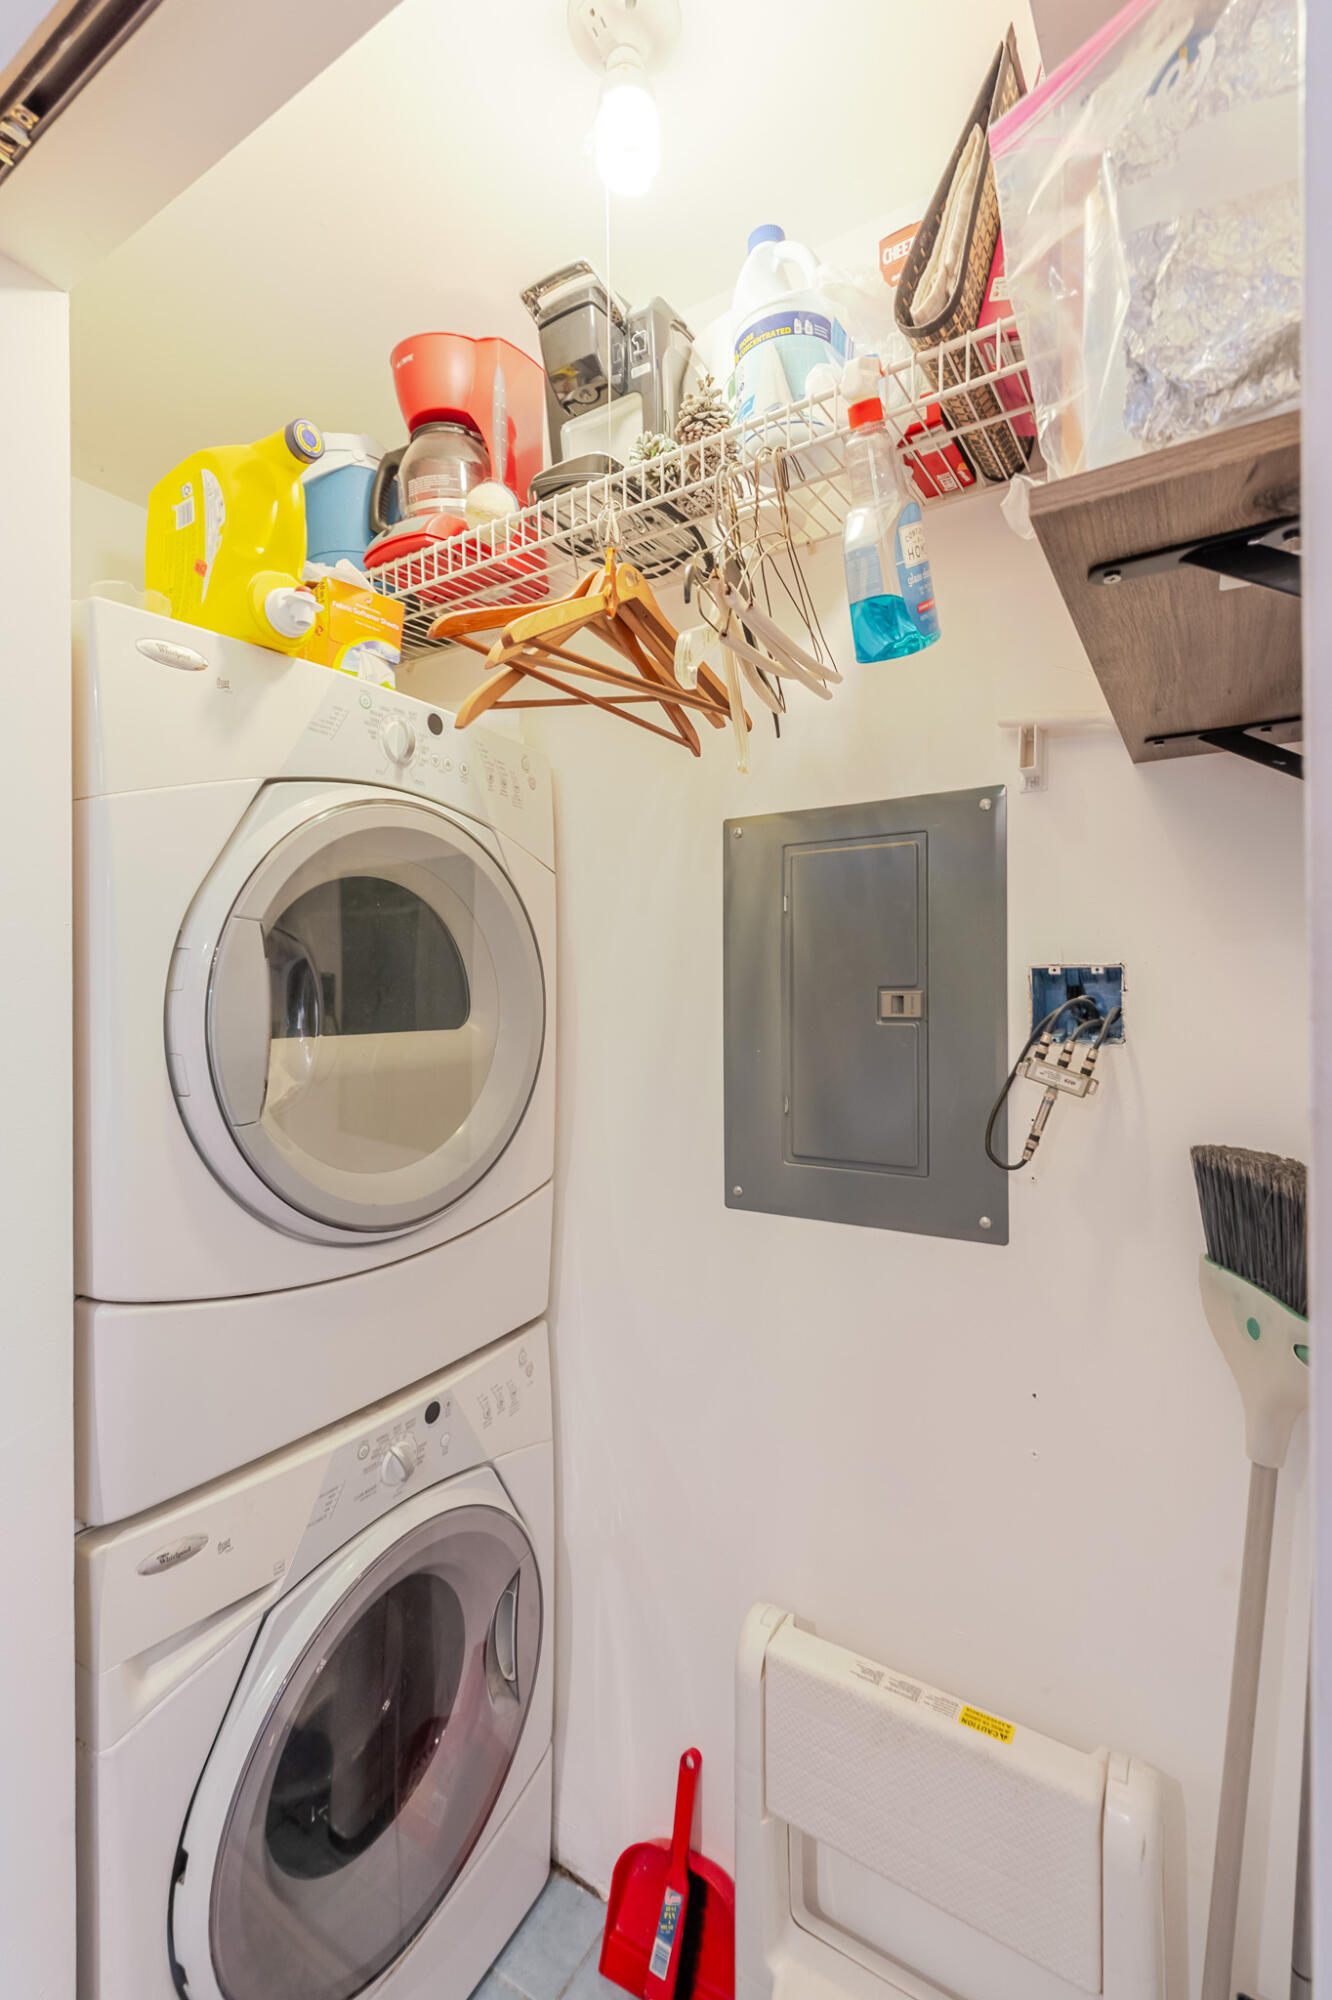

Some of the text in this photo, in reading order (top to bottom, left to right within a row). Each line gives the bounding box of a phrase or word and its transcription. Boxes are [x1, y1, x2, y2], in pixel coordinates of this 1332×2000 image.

[352, 606, 380, 623] Softener
[379, 617, 401, 631] Sheets
[158, 1545, 193, 1566] Whirlpool
[961, 1716, 1000, 1738] CAUTION
